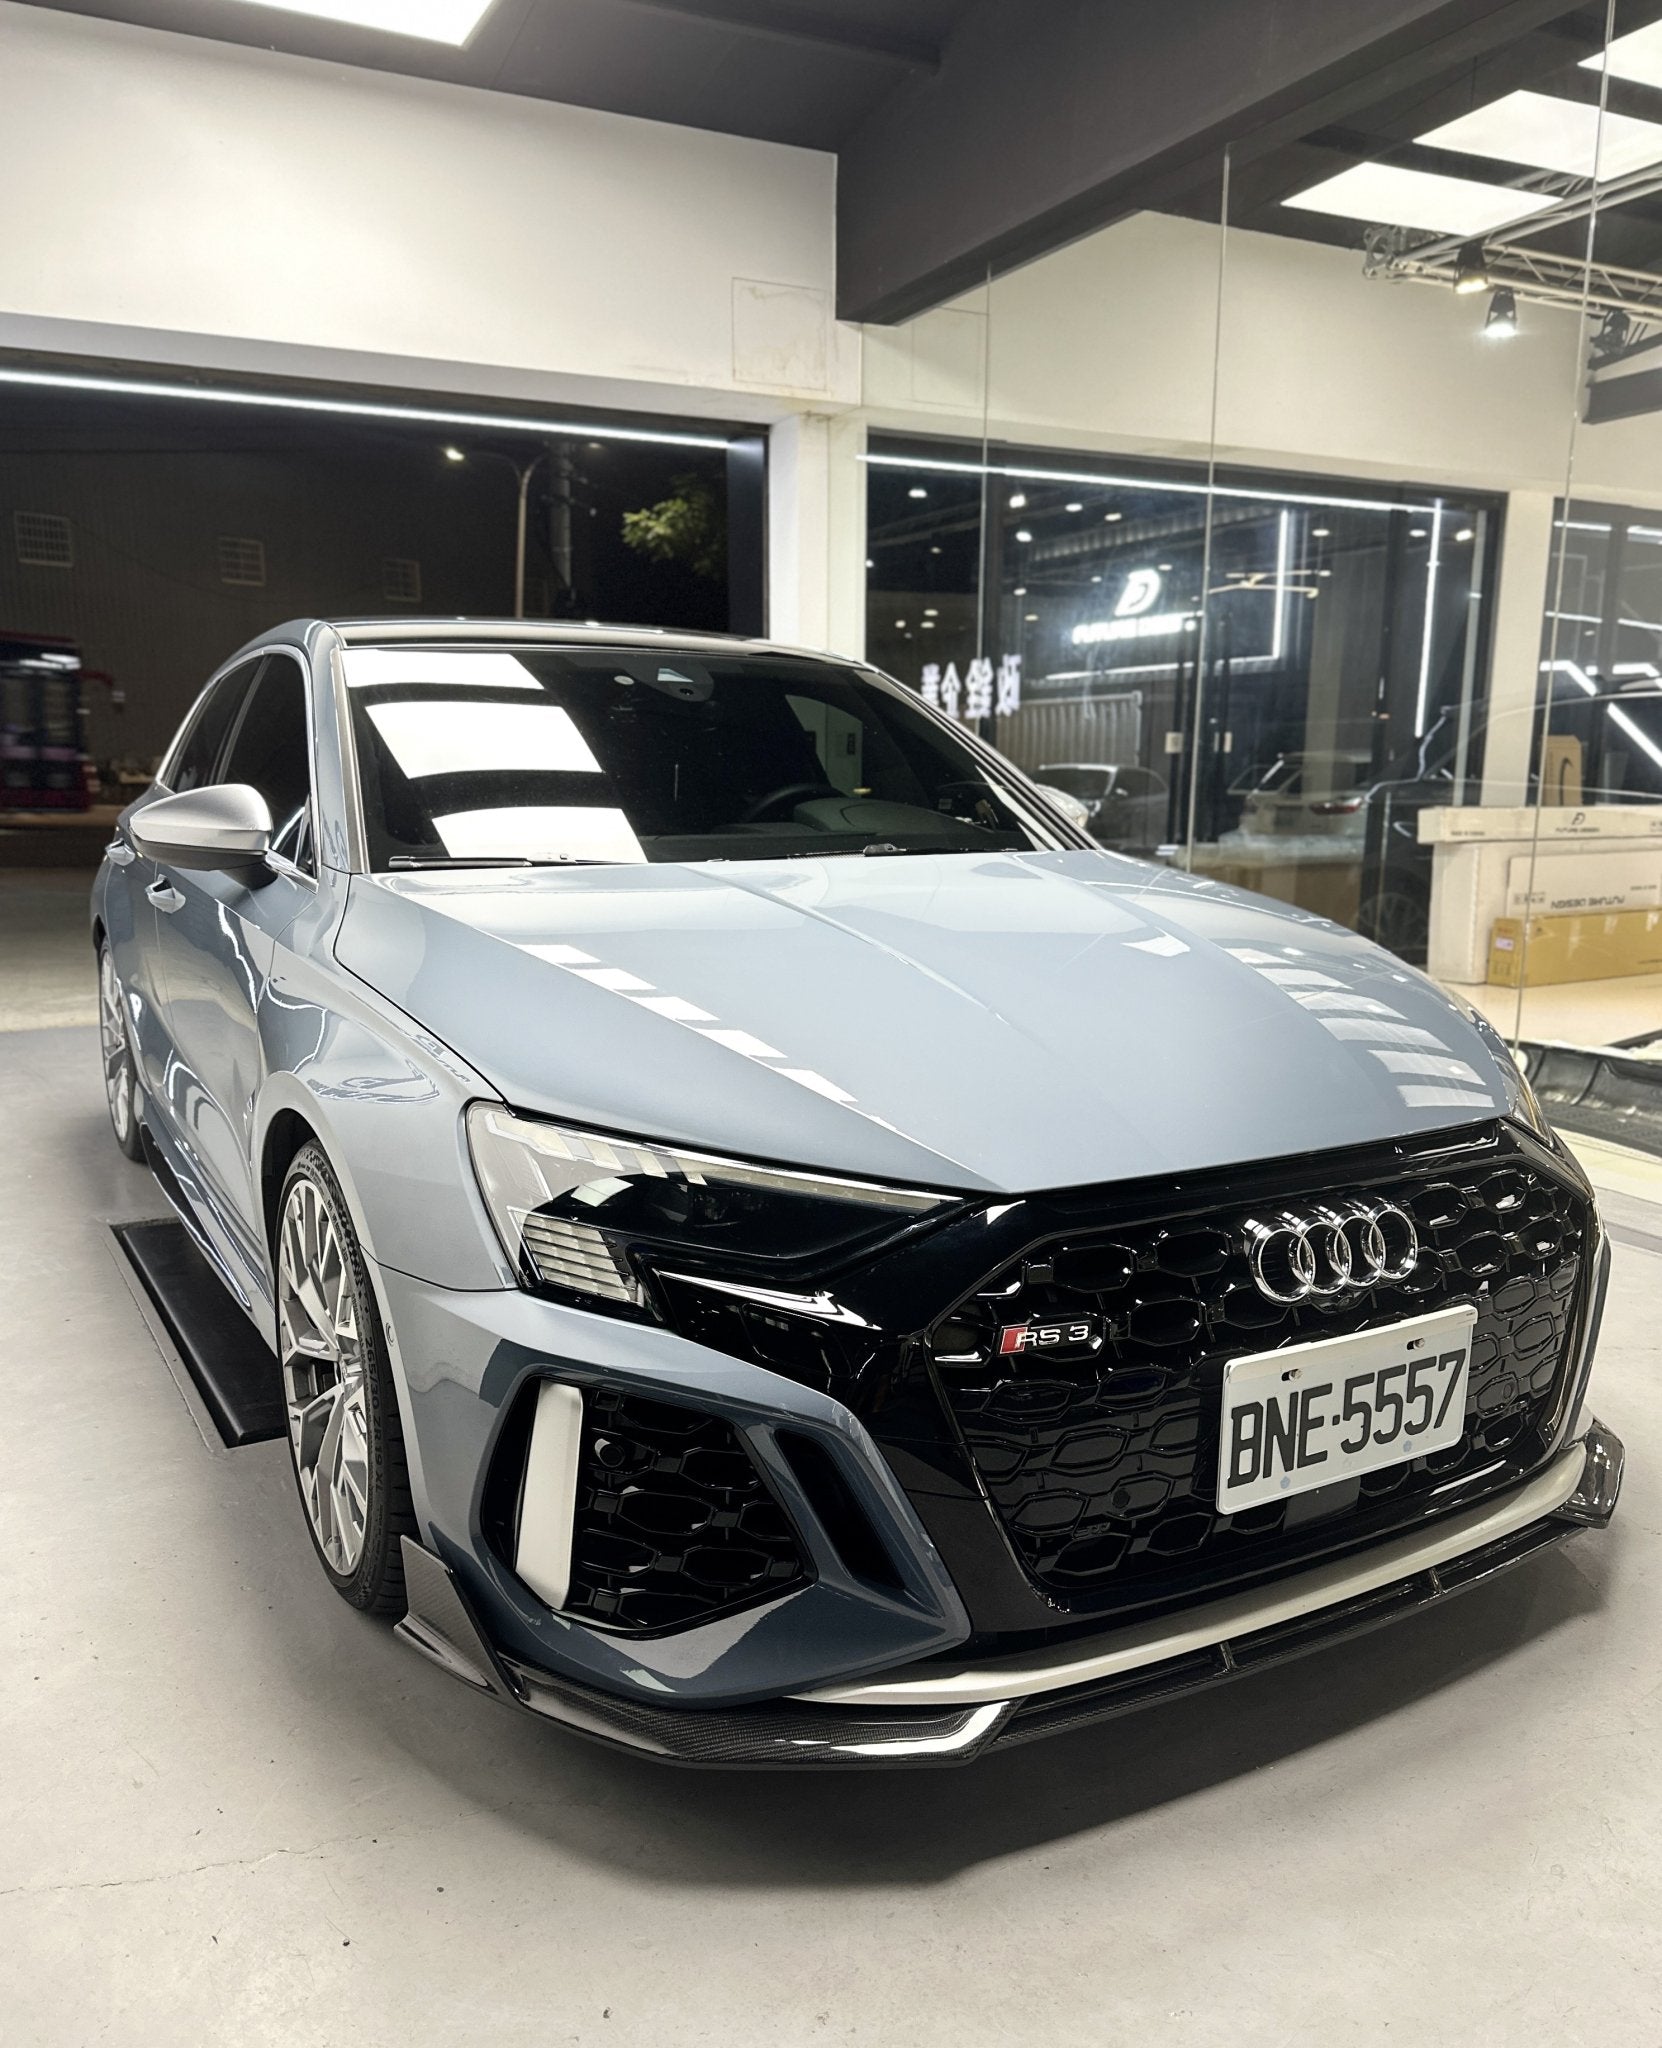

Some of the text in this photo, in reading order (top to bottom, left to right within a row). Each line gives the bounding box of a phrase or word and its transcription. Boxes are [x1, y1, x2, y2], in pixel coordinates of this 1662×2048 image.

[1014, 1325, 1089, 1349] RS 3
[365, 1336, 379, 1410] 265/30
[373, 1415, 383, 1441] ZR
